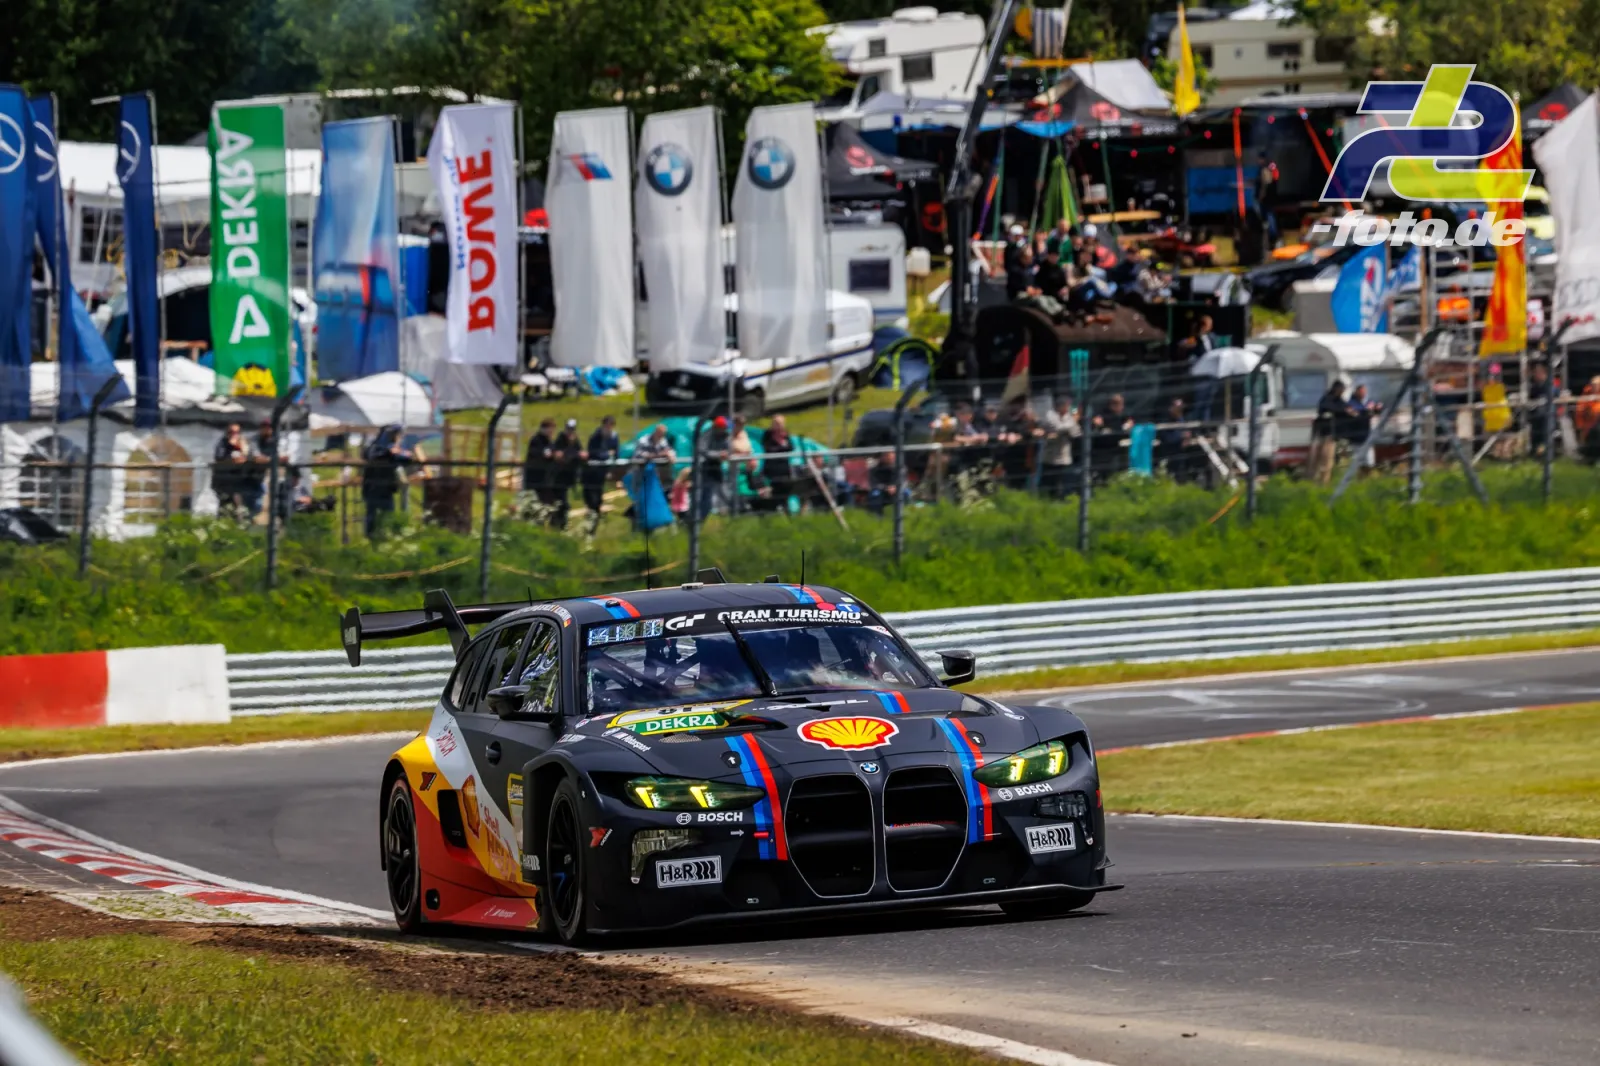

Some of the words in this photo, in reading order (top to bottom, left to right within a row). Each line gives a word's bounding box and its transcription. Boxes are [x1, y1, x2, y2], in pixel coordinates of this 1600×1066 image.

[717, 610, 771, 622] GRAN
[809, 617, 863, 625] SIMULATOR
[646, 714, 718, 732] DEKRA
[1014, 782, 1053, 797] BOSCH
[697, 811, 744, 822] BOSCH
[1029, 829, 1059, 848] H&R
[660, 862, 694, 881] H&R
